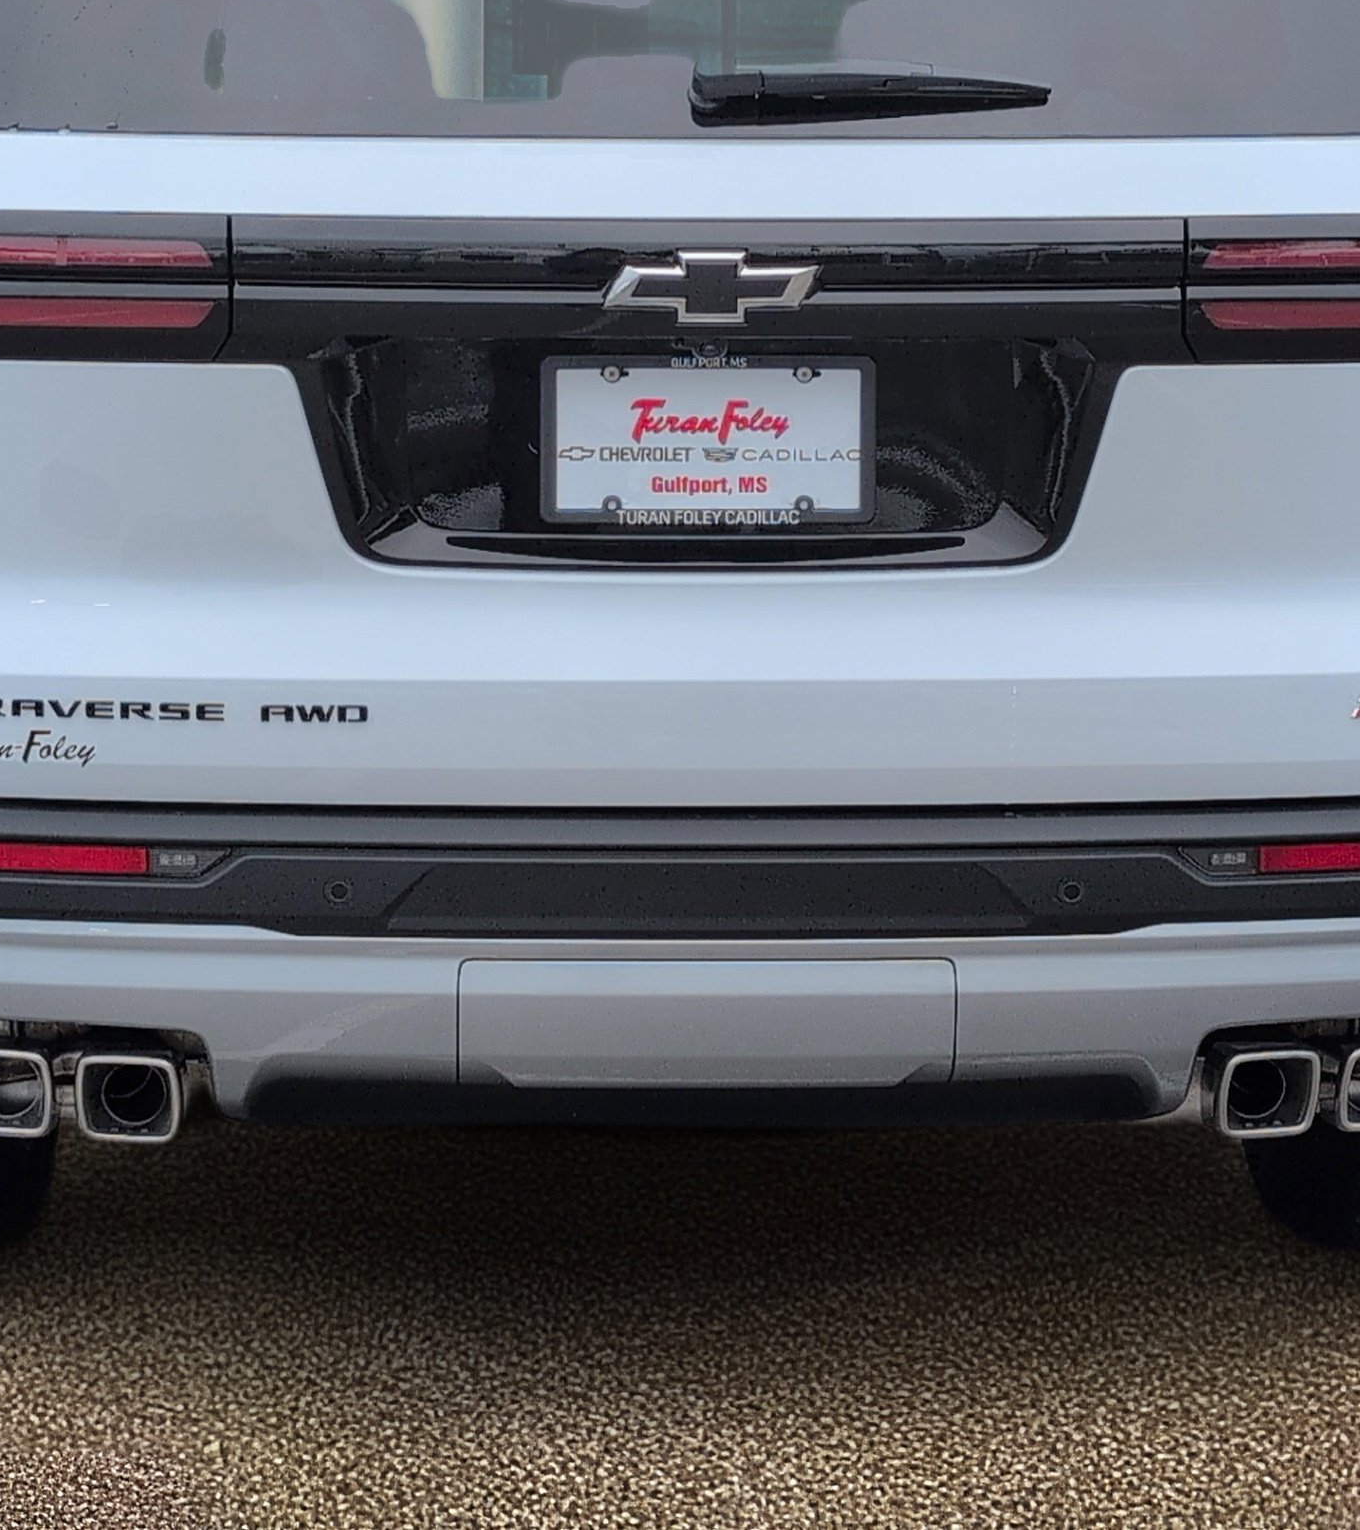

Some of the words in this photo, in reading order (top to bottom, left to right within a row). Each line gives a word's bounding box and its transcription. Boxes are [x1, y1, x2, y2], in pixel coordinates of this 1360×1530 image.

[598, 446, 696, 462] CHEVROLET
[741, 448, 865, 462] CADILLAC
[651, 476, 733, 495] Gulfport,
[738, 476, 768, 493] MS
[616, 509, 673, 525] TURAN
[674, 509, 724, 525] FOLEY
[725, 509, 801, 525] CADILLAC
[260, 704, 369, 723] AWD
